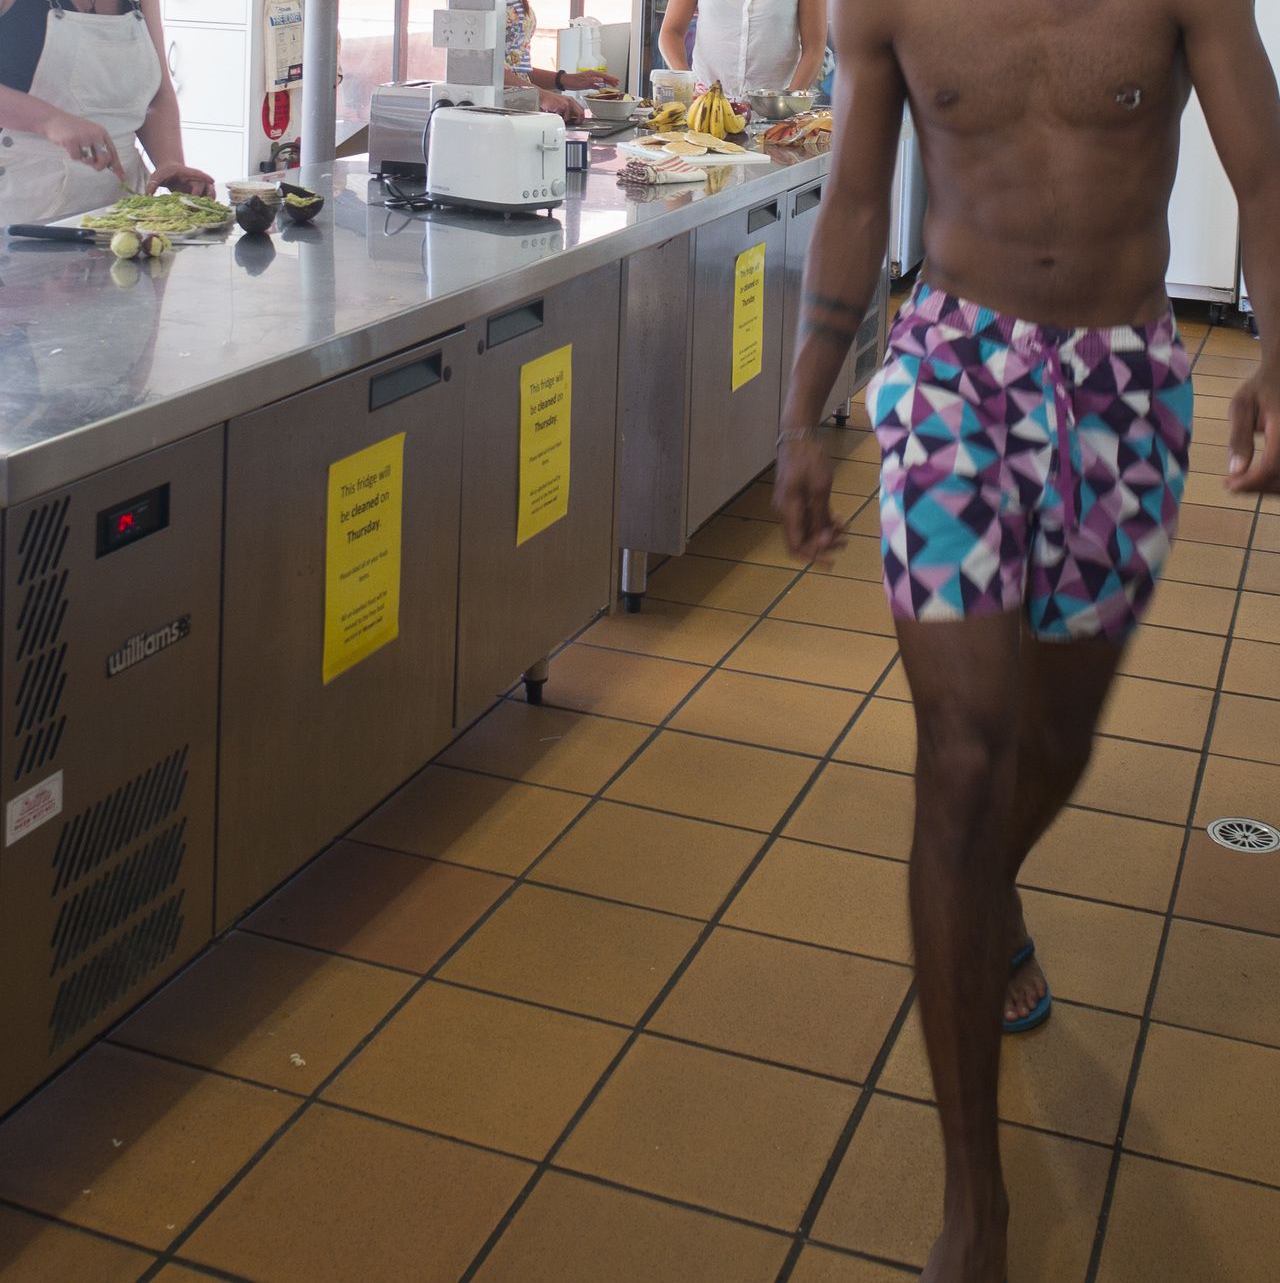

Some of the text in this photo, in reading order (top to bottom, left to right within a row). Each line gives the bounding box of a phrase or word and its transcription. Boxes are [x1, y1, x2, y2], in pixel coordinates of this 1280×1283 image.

[530, 369, 564, 394] This fridge will
[529, 403, 537, 416] be
[537, 394, 557, 413] cleaned
[340, 465, 391, 499] This fridge will
[340, 491, 390, 523] be cleaned on
[108, 621, 179, 674] williams
